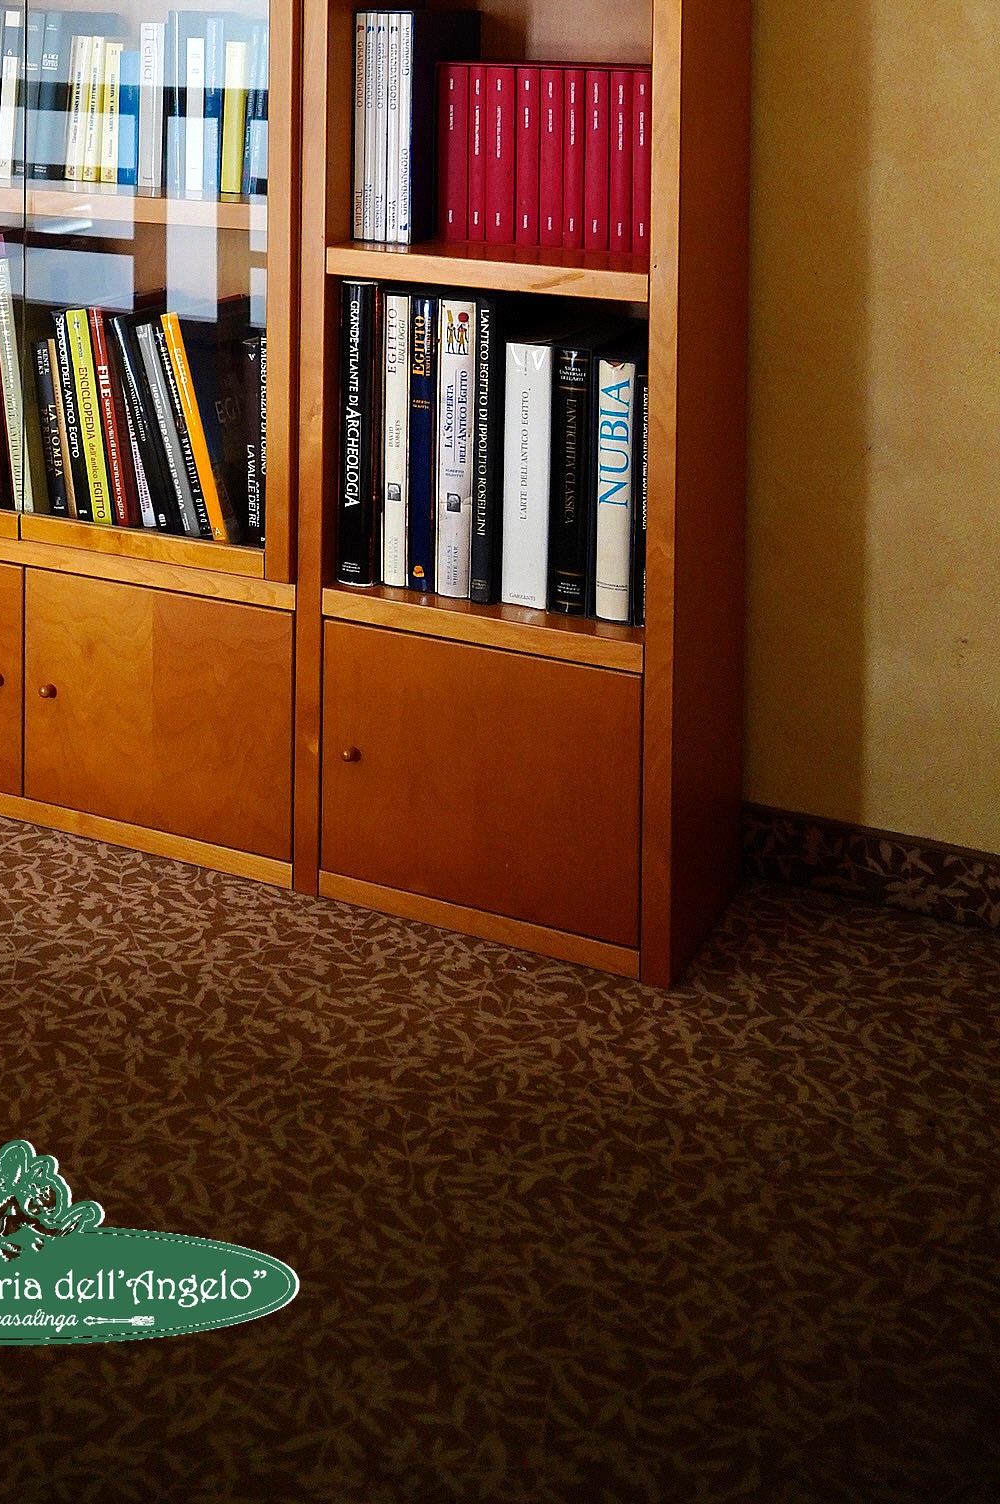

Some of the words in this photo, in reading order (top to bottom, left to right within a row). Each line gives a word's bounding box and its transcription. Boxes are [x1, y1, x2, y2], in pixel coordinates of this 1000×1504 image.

[355, 40, 363, 108] GRANDANGOLO
[366, 41, 374, 109] GRANDANGOLO
[388, 43, 397, 111] GRANDANGOLO
[354, 189, 363, 228] TURCHIA
[349, 300, 359, 339] GRANDE
[479, 309, 491, 361] L'ANTICO
[42, 348, 50, 364] KENT
[387, 307, 397, 374] EGITTO
[411, 314, 425, 377] EGITTO
[36, 348, 44, 376] WEEKS
[347, 341, 359, 393] ATLANTE
[459, 370, 469, 399] EGITTO
[479, 363, 489, 400] EGITTO
[48, 403, 58, 420] LA
[150, 382, 165, 419] Faraoni
[347, 395, 358, 406] DI
[444, 383, 454, 434] SCOPERTA
[478, 402, 489, 414] DI
[520, 391, 529, 429] EGITTO
[68, 426, 80, 459] EGITTO
[78, 366, 95, 440] ENCICLOPEDIA
[93, 481, 106, 519] EGITTO
[97, 365, 111, 399] FILE
[115, 496, 126, 520] egizio
[159, 419, 170, 434] dei
[444, 436, 453, 449] LA
[477, 415, 488, 475] IPPOLITO
[599, 379, 631, 507] NUBIA
[50, 427, 64, 477] TOMBA
[162, 435, 177, 468] tempo
[246, 444, 256, 458] LA
[344, 407, 362, 508] ARCHEOLOGIA
[519, 432, 528, 489] DELL'ANTICO
[168, 468, 178, 478] al
[247, 459, 256, 493] VALLE
[172, 478, 186, 510] Vivere
[248, 494, 257, 511] DEI
[475, 478, 487, 537] ROSELLINI
[519, 491, 528, 521] L'ARTE
[248, 513, 257, 527] RE
[509, 591, 536, 602] GARZANTI
